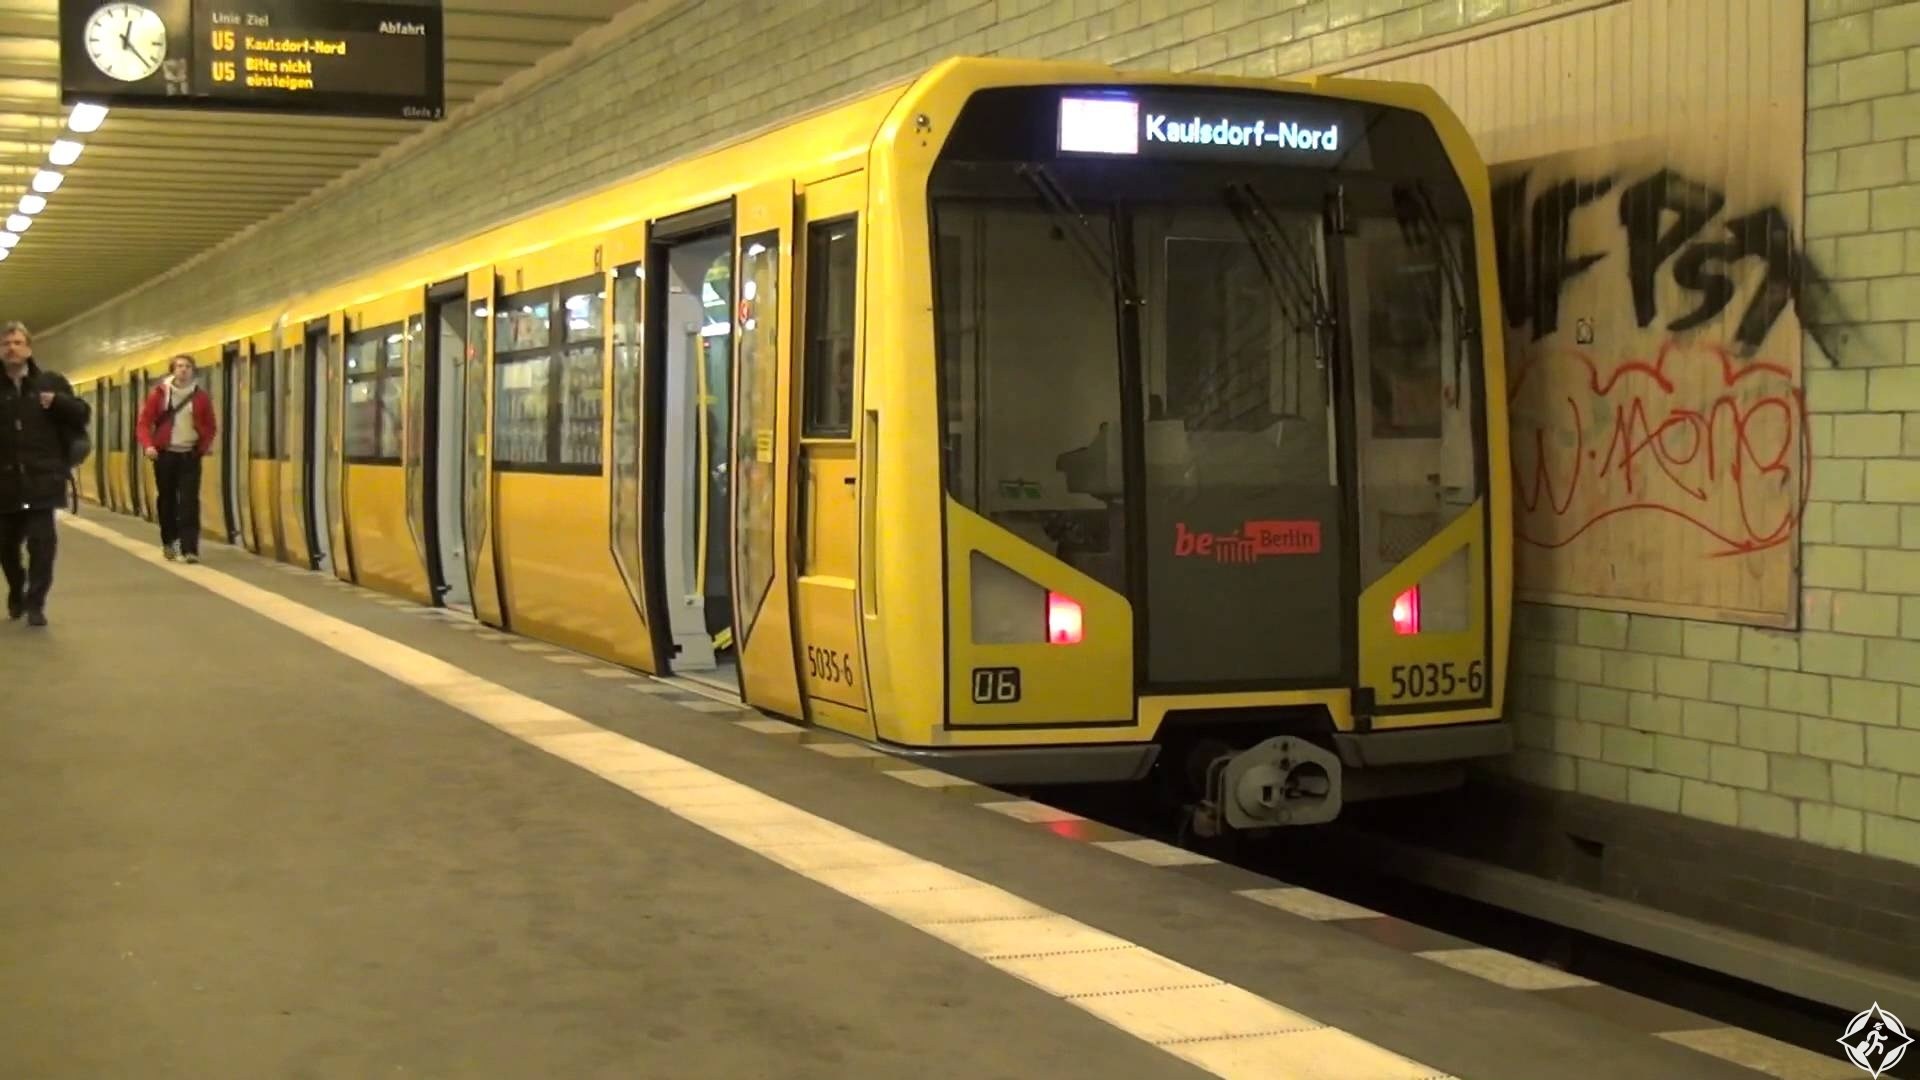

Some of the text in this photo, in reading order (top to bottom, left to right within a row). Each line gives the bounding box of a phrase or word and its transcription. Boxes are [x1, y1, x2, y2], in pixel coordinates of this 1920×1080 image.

[212, 12, 269, 27] Linie Ziel
[379, 21, 425, 36] Abfahrt
[212, 30, 346, 55] U5 Kaulsdorf-Nord
[212, 57, 312, 82] U5 Bitte nicht
[246, 74, 313, 90] einsteigen
[1146, 114, 1338, 151] Kaulsdorf-Nord
[1175, 522, 1313, 556] be Berlin
[807, 645, 853, 688] 5035-6
[1391, 659, 1483, 699] 5035-6
[974, 671, 1017, 702] 06
